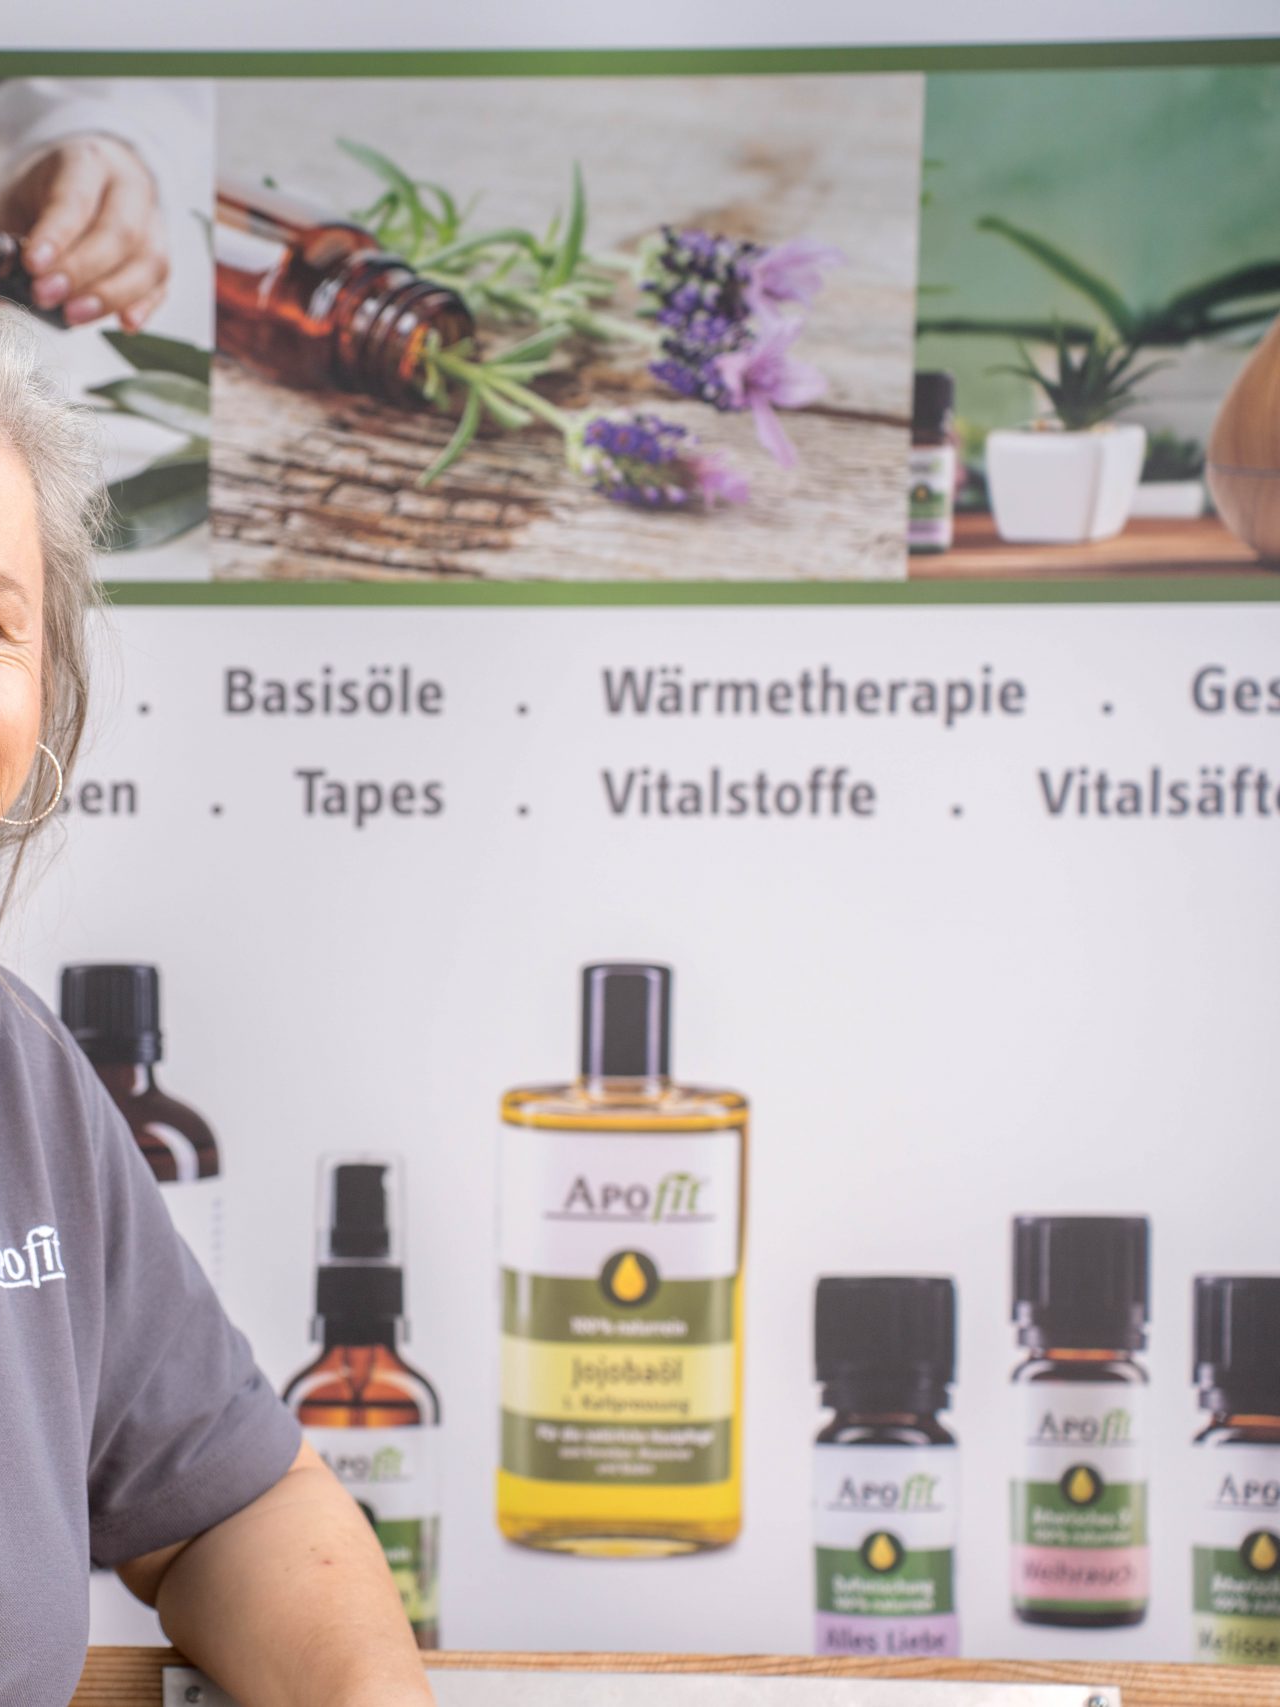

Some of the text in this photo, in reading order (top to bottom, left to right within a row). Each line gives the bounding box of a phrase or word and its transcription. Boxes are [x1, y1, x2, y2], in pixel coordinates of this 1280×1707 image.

[225, 665, 444, 715] Basisöle
[601, 664, 1027, 728] Wärmetherapie
[295, 769, 444, 828] Tapes
[601, 767, 876, 817] Vitalstoffe
[1038, 765, 1280, 817] Vitalsäft
[572, 1355, 683, 1390] Jojobaöl
